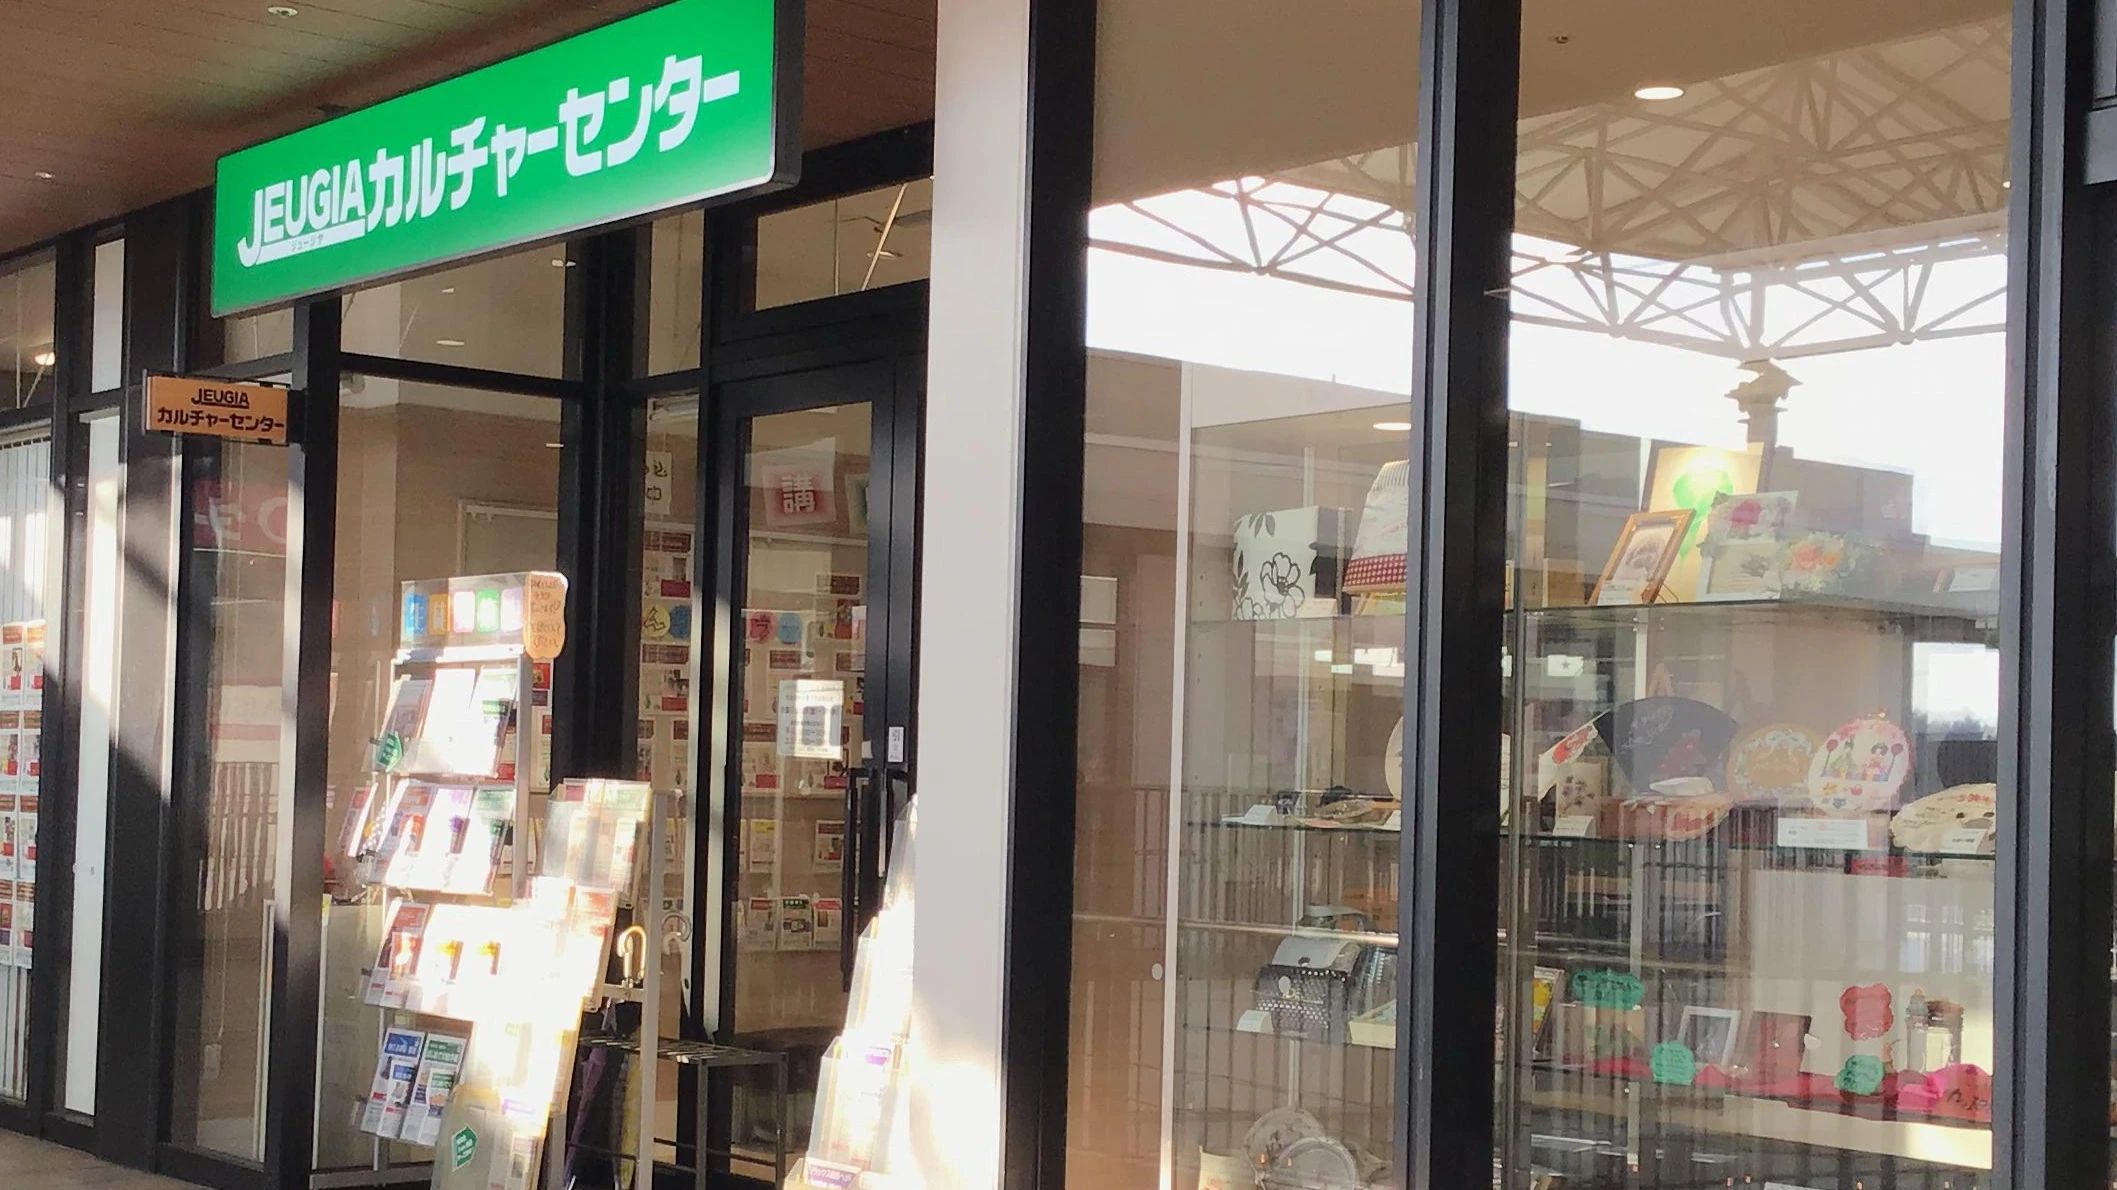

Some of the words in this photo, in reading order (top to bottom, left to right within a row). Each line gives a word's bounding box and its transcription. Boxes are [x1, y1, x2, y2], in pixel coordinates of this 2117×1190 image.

[191, 388, 250, 406] JEUGIA
[157, 406, 285, 432] カルチャーセンター
[780, 475, 817, 514] 講
